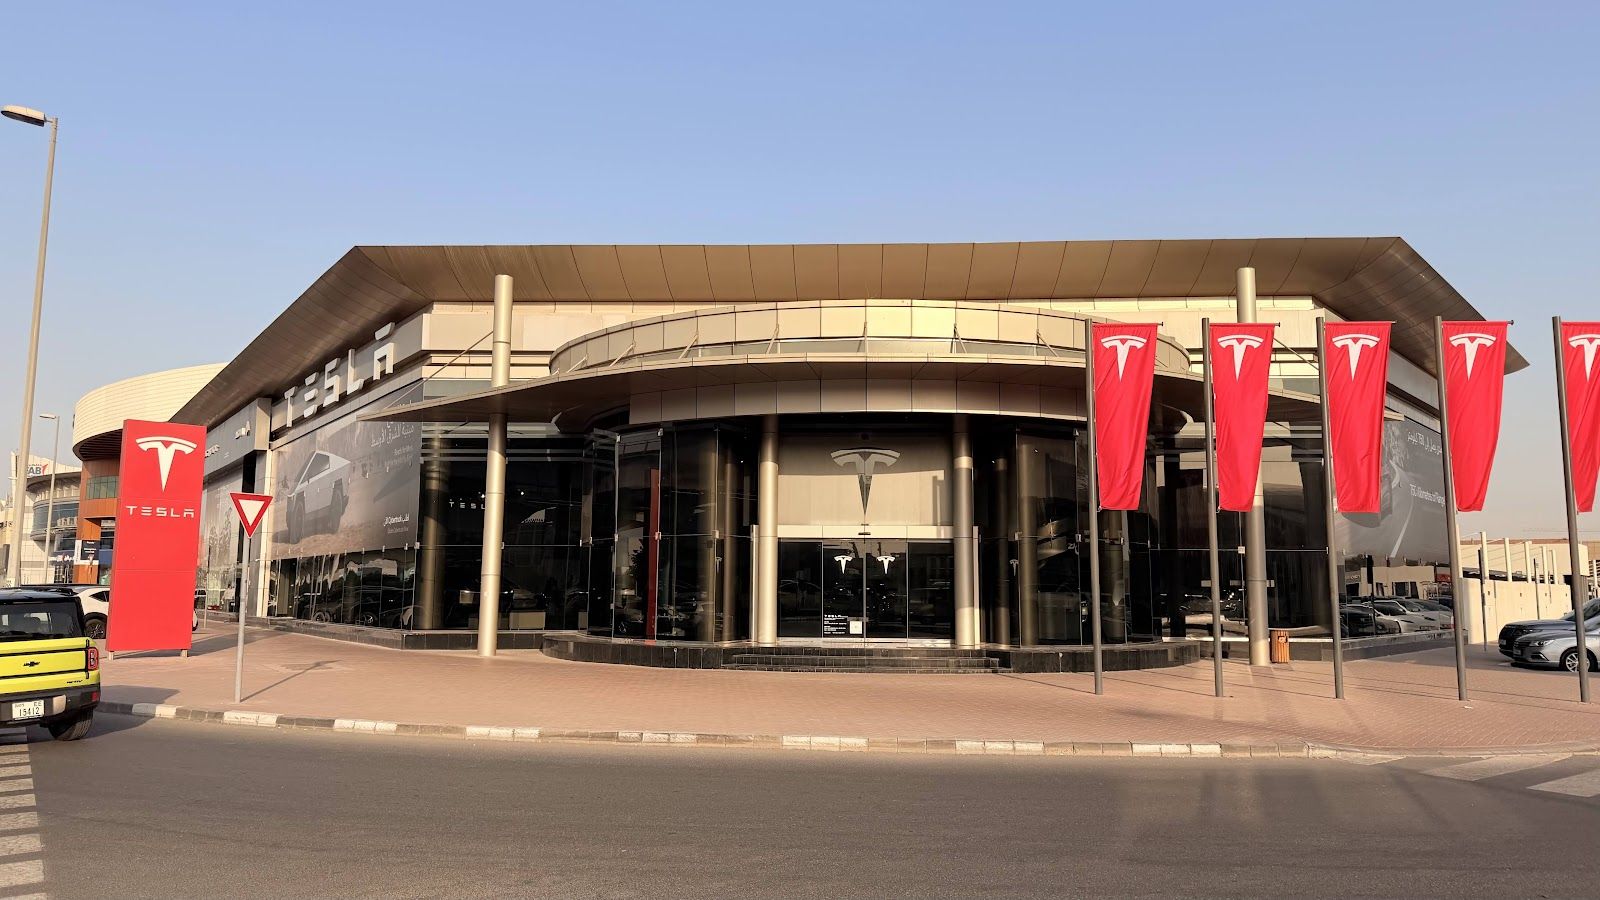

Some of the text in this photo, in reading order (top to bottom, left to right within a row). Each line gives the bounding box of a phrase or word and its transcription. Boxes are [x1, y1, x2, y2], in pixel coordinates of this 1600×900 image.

[283, 322, 396, 428] TESLA
[26, 466, 42, 475] AB
[449, 501, 485, 509] TESL
[125, 505, 195, 518] TESLA
